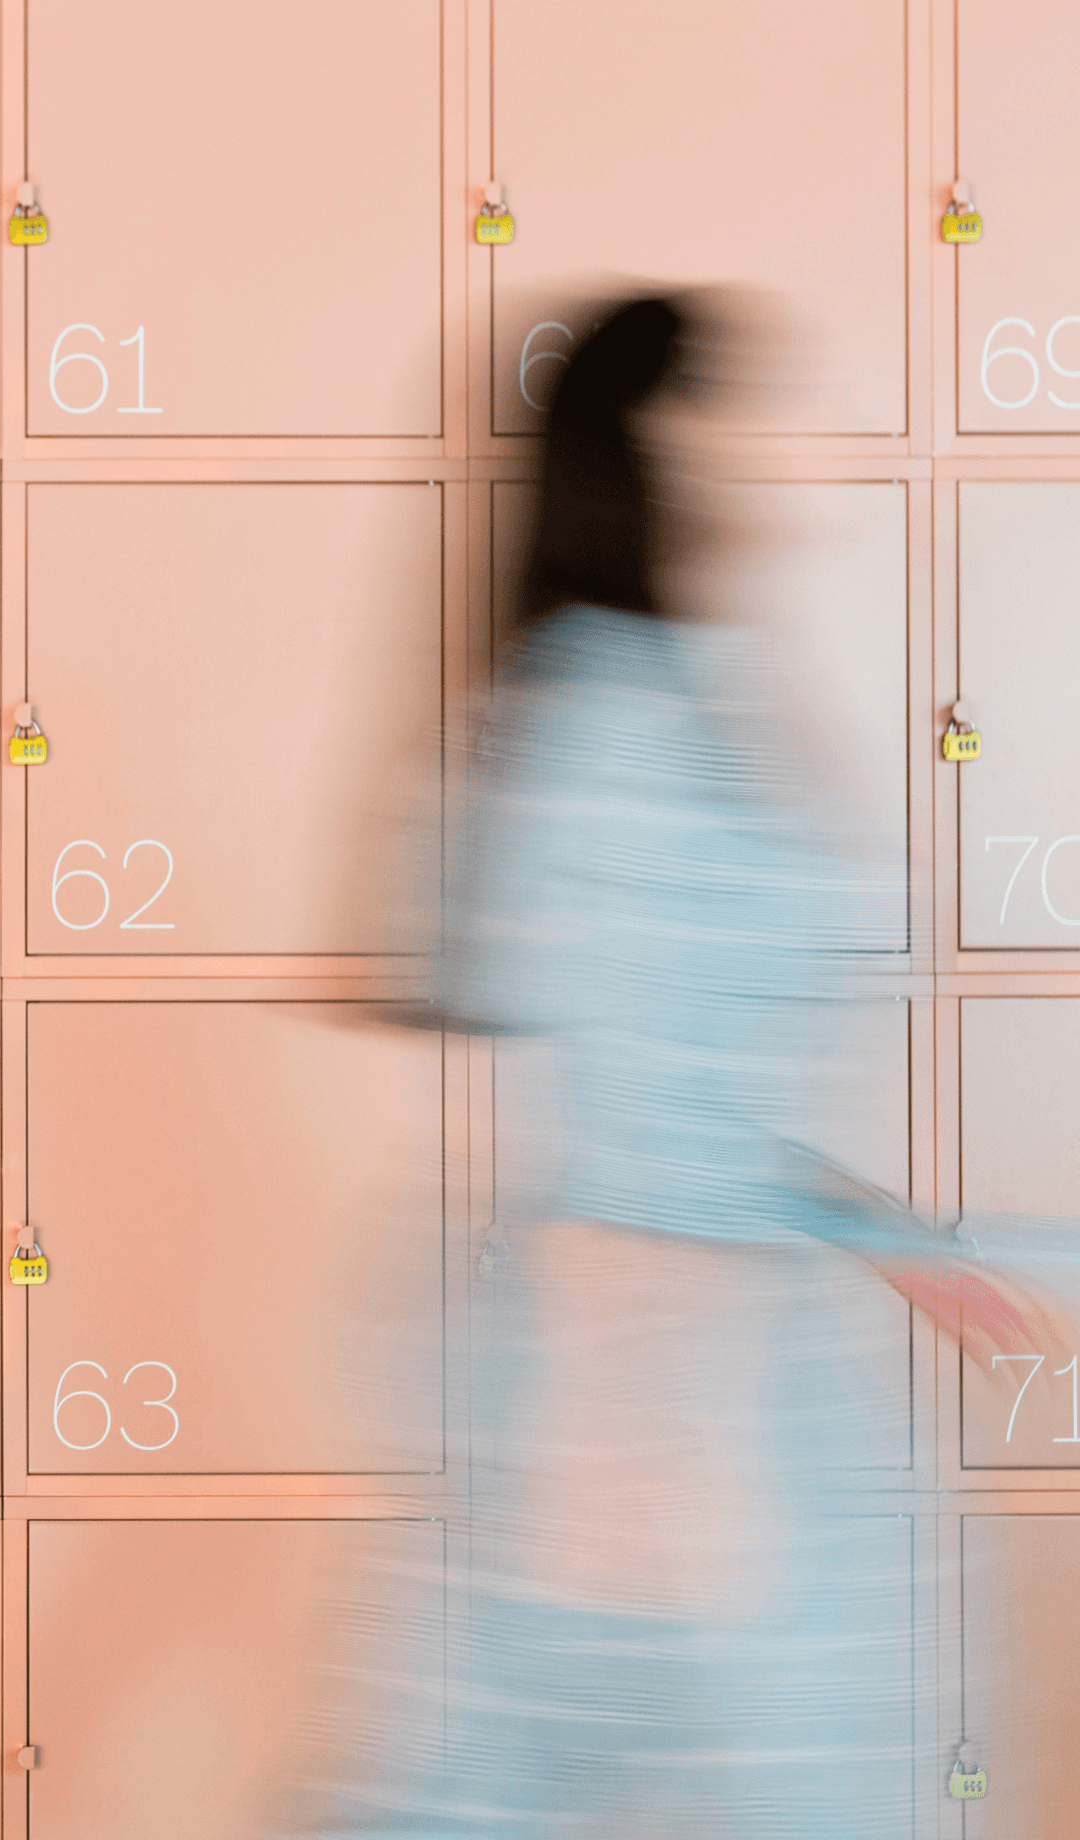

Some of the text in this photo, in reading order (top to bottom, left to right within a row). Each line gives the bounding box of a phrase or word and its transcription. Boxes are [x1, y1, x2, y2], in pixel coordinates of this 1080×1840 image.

[49, 324, 163, 414] 61
[981, 316, 1080, 409] 69
[51, 839, 176, 931] 62
[984, 835, 1080, 926] 70
[52, 1360, 180, 1451] 63
[991, 1354, 1080, 1444] 71
